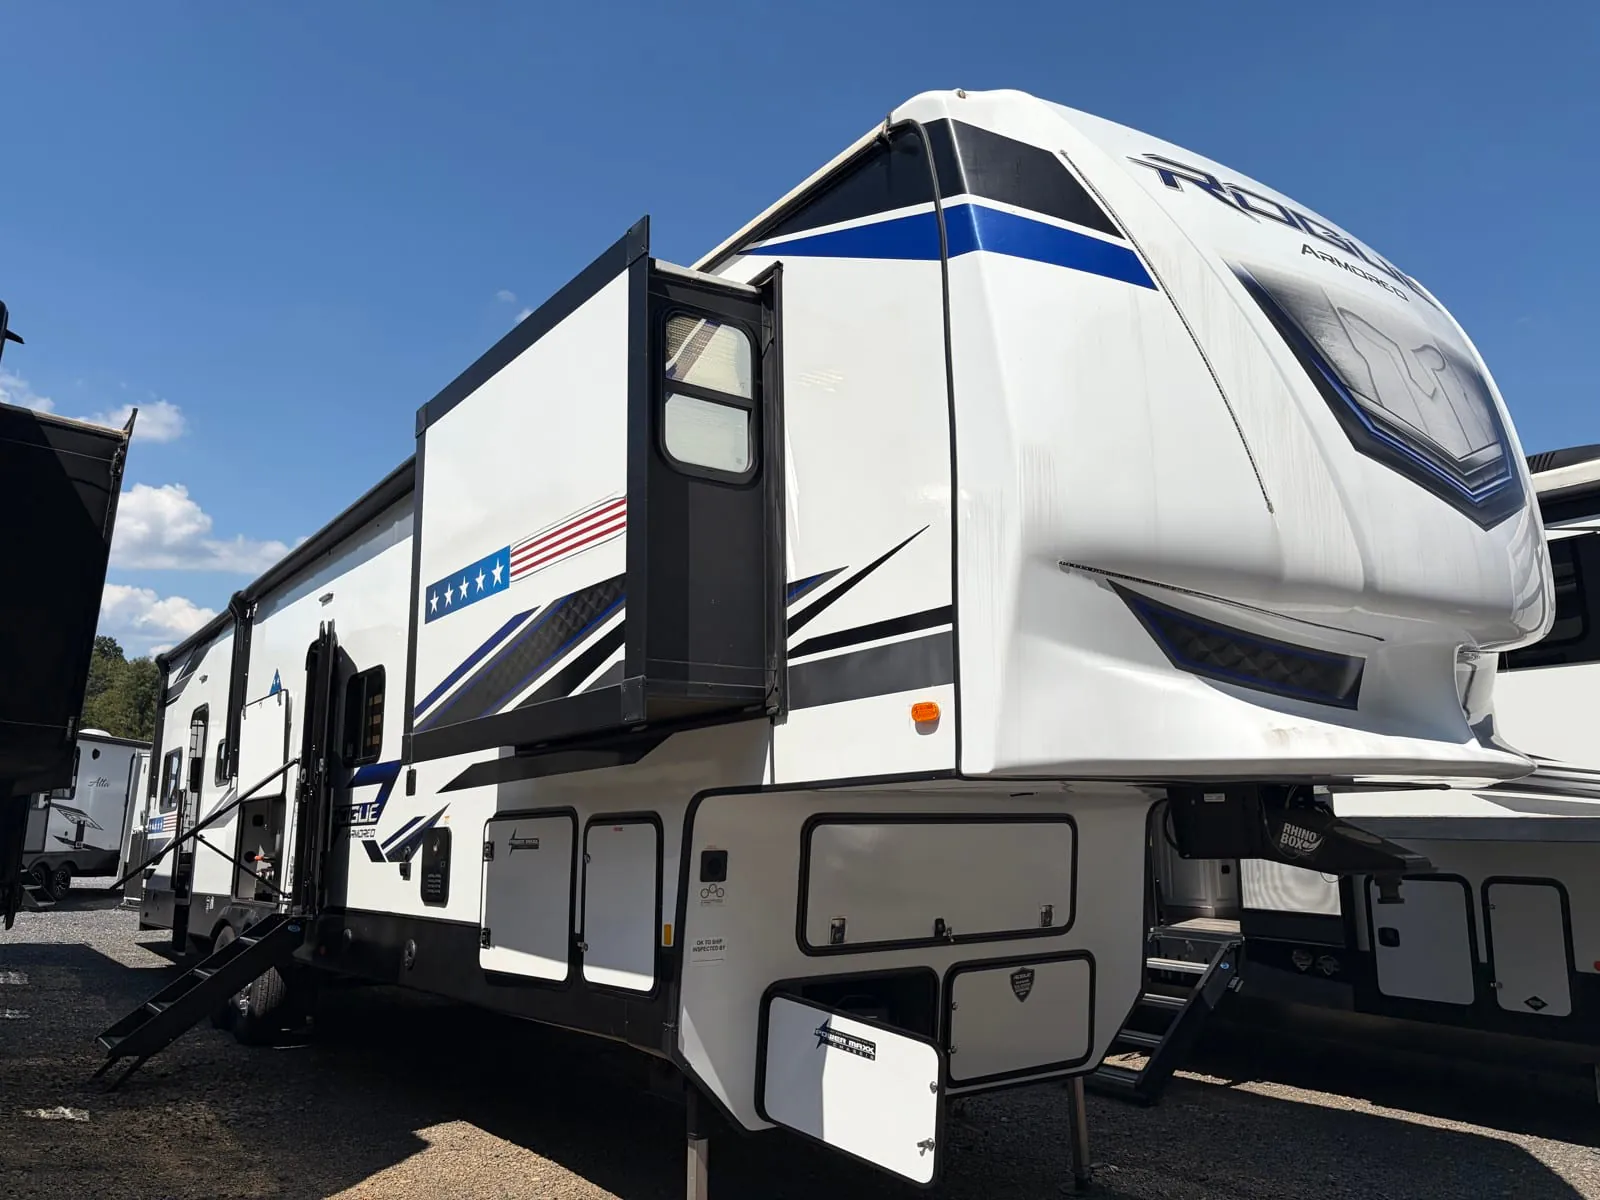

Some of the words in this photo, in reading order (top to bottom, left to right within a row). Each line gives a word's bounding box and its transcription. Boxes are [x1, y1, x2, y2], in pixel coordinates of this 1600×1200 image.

[1126, 153, 1442, 312] ROGUE
[1301, 243, 1409, 302] ARMORED
[1281, 833, 1304, 849] BOX
[1283, 823, 1316, 842] RHINO
